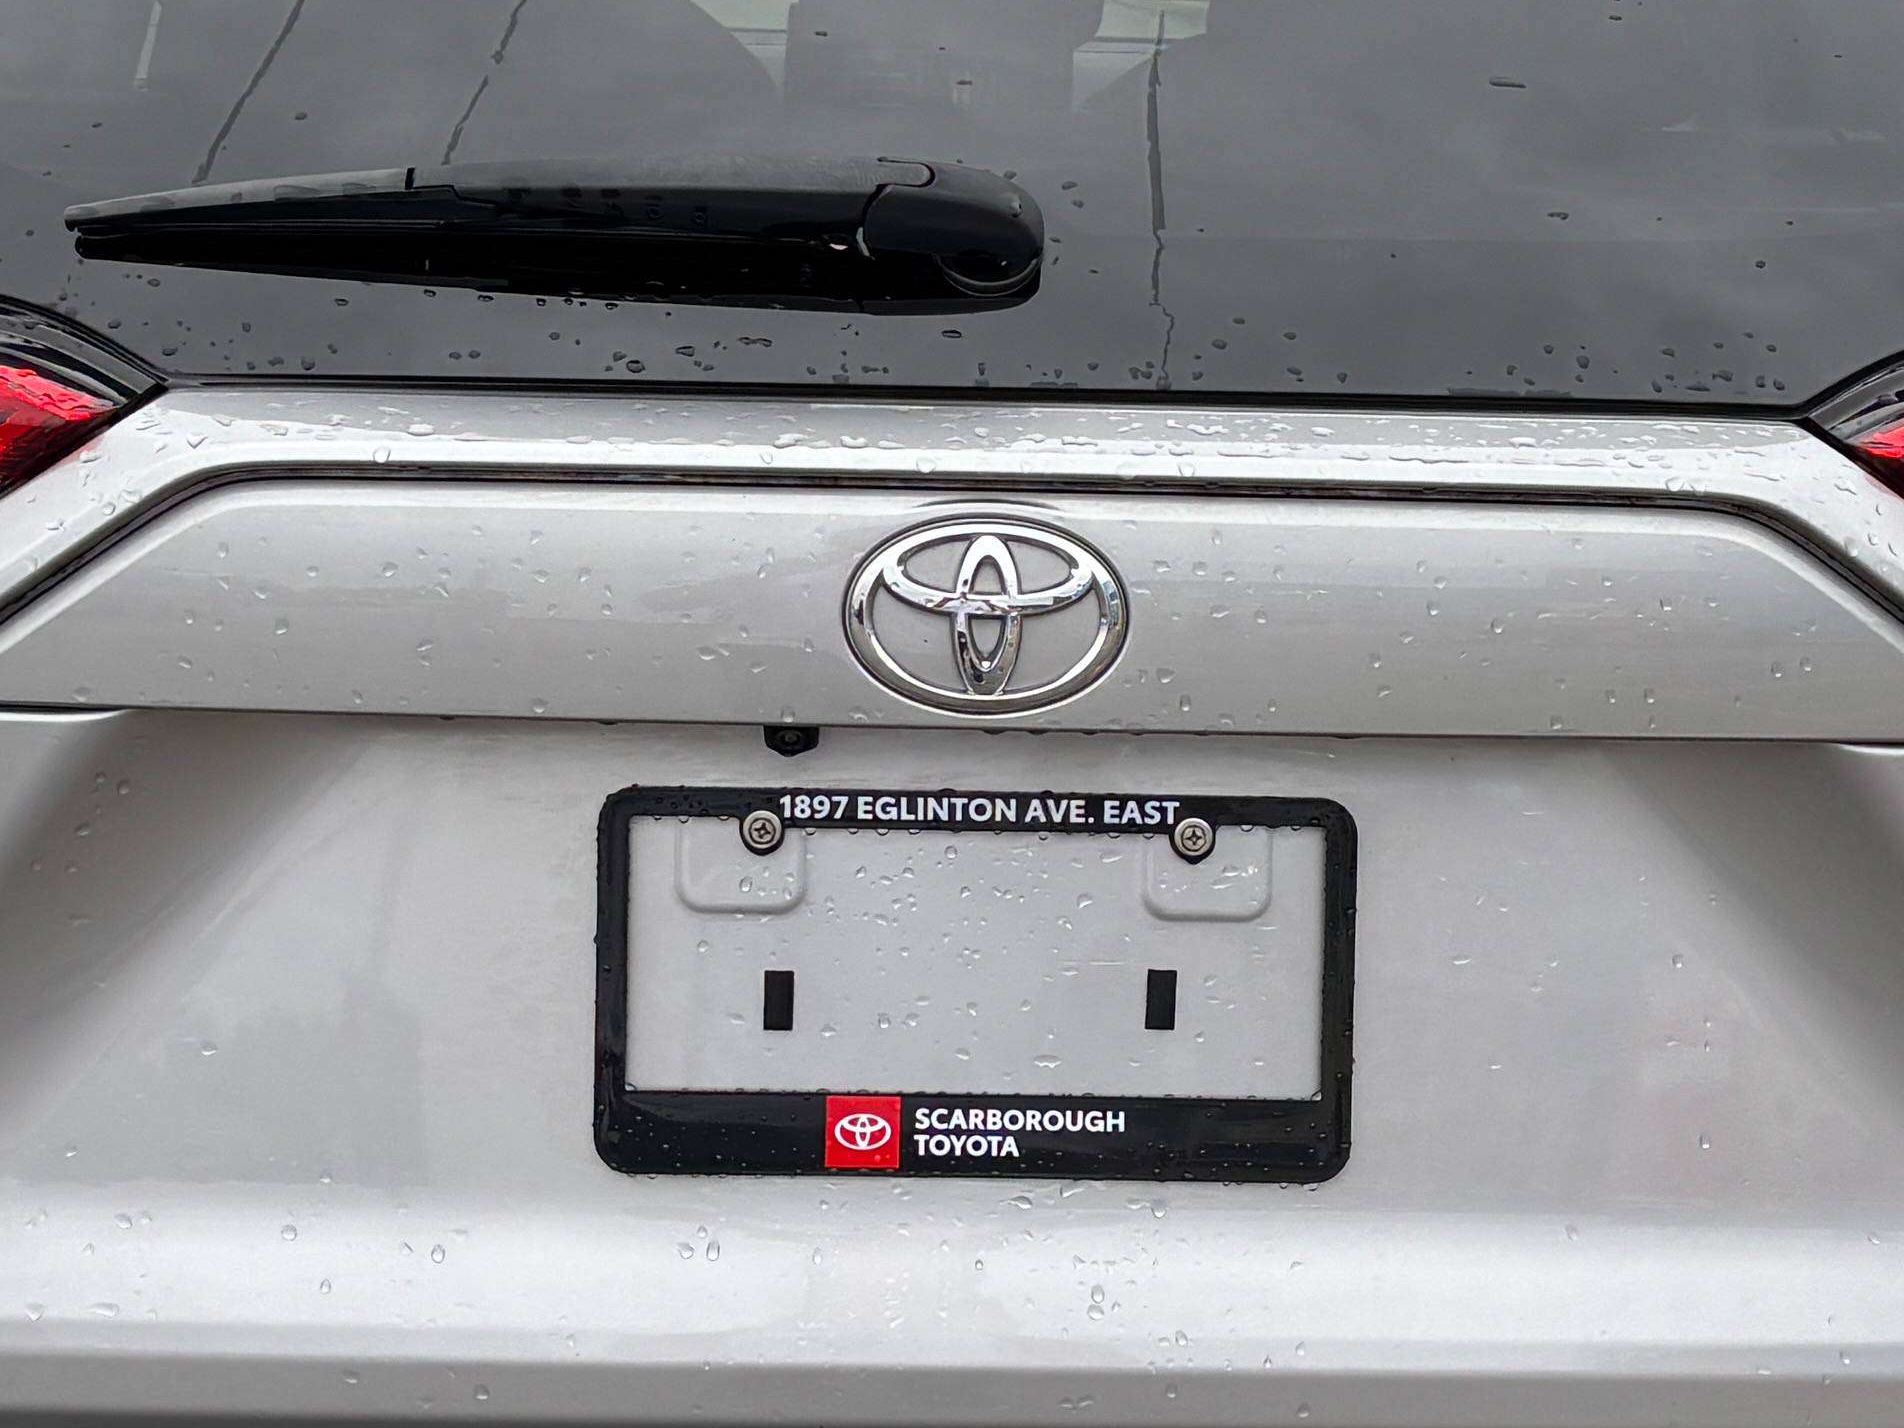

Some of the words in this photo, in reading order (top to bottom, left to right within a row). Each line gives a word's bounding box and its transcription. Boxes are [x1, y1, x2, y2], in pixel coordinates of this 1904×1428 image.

[779, 794, 849, 820] 1897
[857, 795, 1017, 824] EGLINTON
[1024, 798, 1095, 824] AVE.
[1103, 800, 1180, 825] EAST
[914, 1107, 1126, 1132] SCARBOROUGH
[913, 1134, 1021, 1157] TOYOTA
